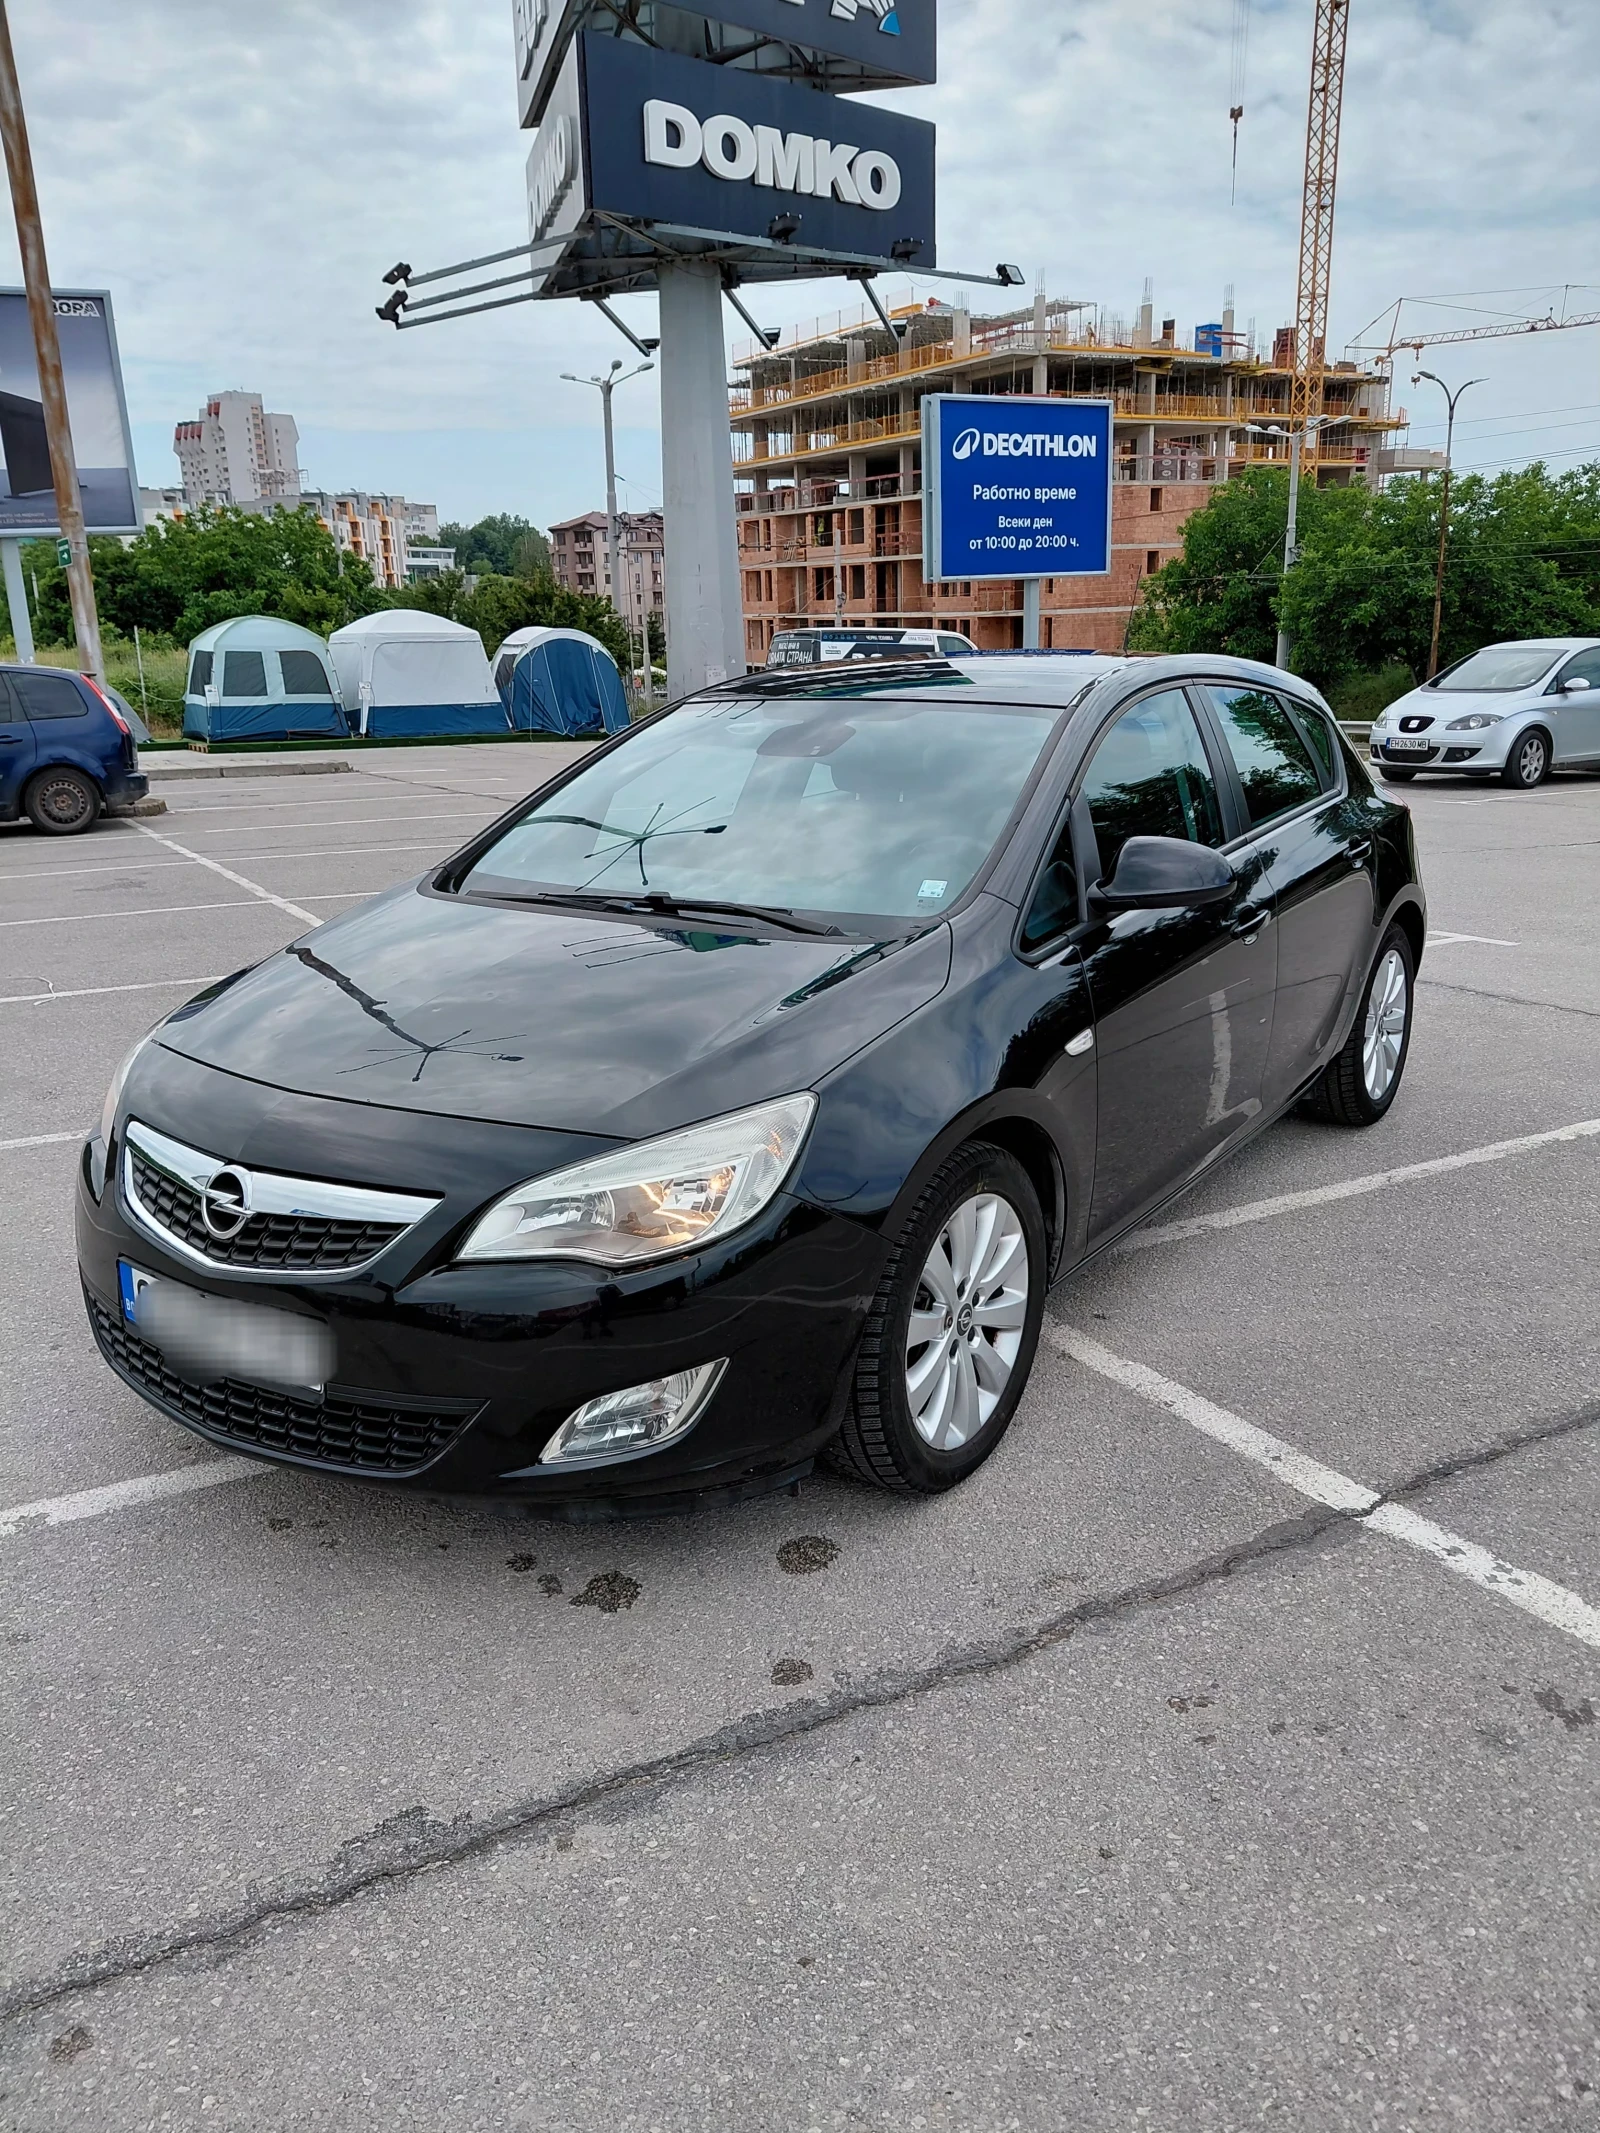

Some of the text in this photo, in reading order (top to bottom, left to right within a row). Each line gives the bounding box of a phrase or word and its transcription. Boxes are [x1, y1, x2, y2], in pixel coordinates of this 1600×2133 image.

[643, 98, 901, 210] DOMKO
[983, 432, 1097, 458] DECATHLON
[973, 484, 1077, 504] Работно време
[998, 515, 1053, 530] Всеки ден
[969, 539, 983, 550] от
[985, 535, 1016, 549] 10:00
[1018, 538, 1033, 551] до
[1035, 535, 1068, 548] 20:00
[786, 651, 813, 664] СТРАНА
[1400, 740, 1417, 749] 2630
